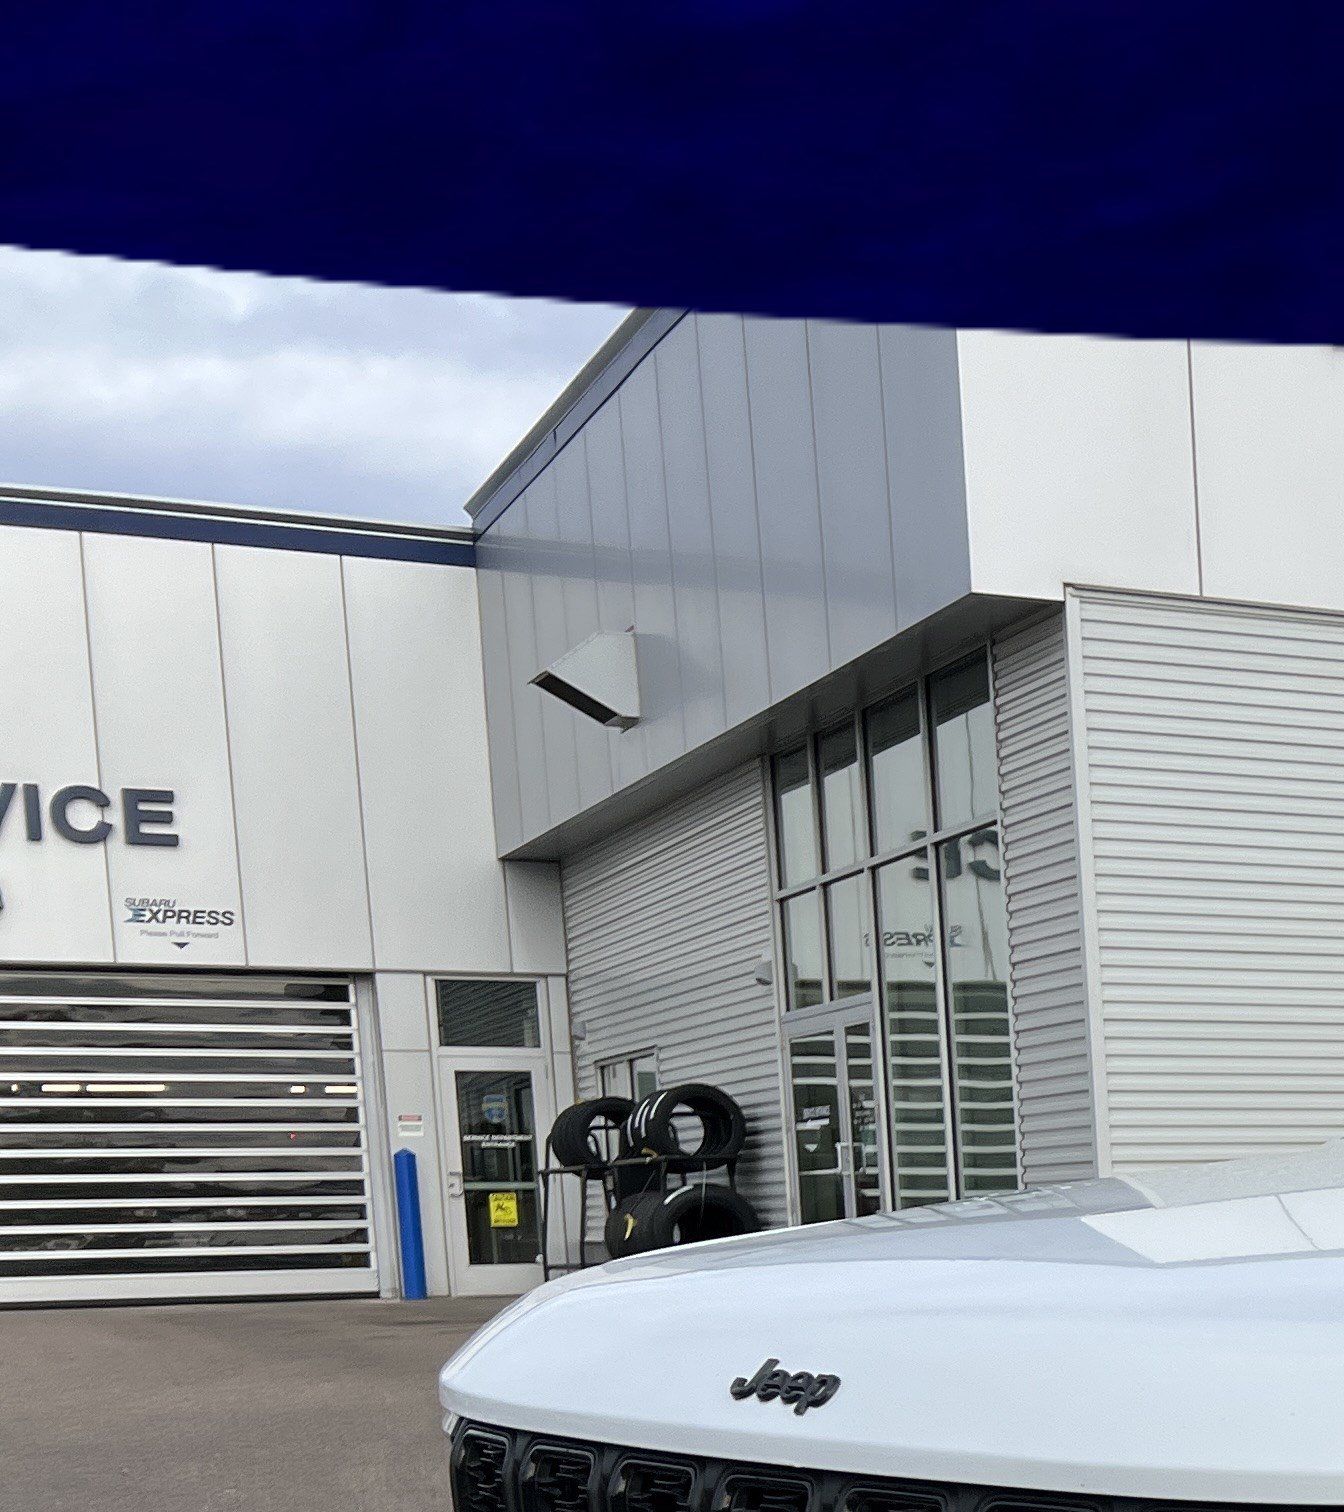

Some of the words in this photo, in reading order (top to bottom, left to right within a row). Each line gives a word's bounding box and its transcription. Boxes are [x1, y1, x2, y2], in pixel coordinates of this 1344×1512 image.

[124, 897, 176, 909] SUBARU
[124, 908, 235, 926] EXPRESS
[730, 1358, 841, 1416] Jeep
